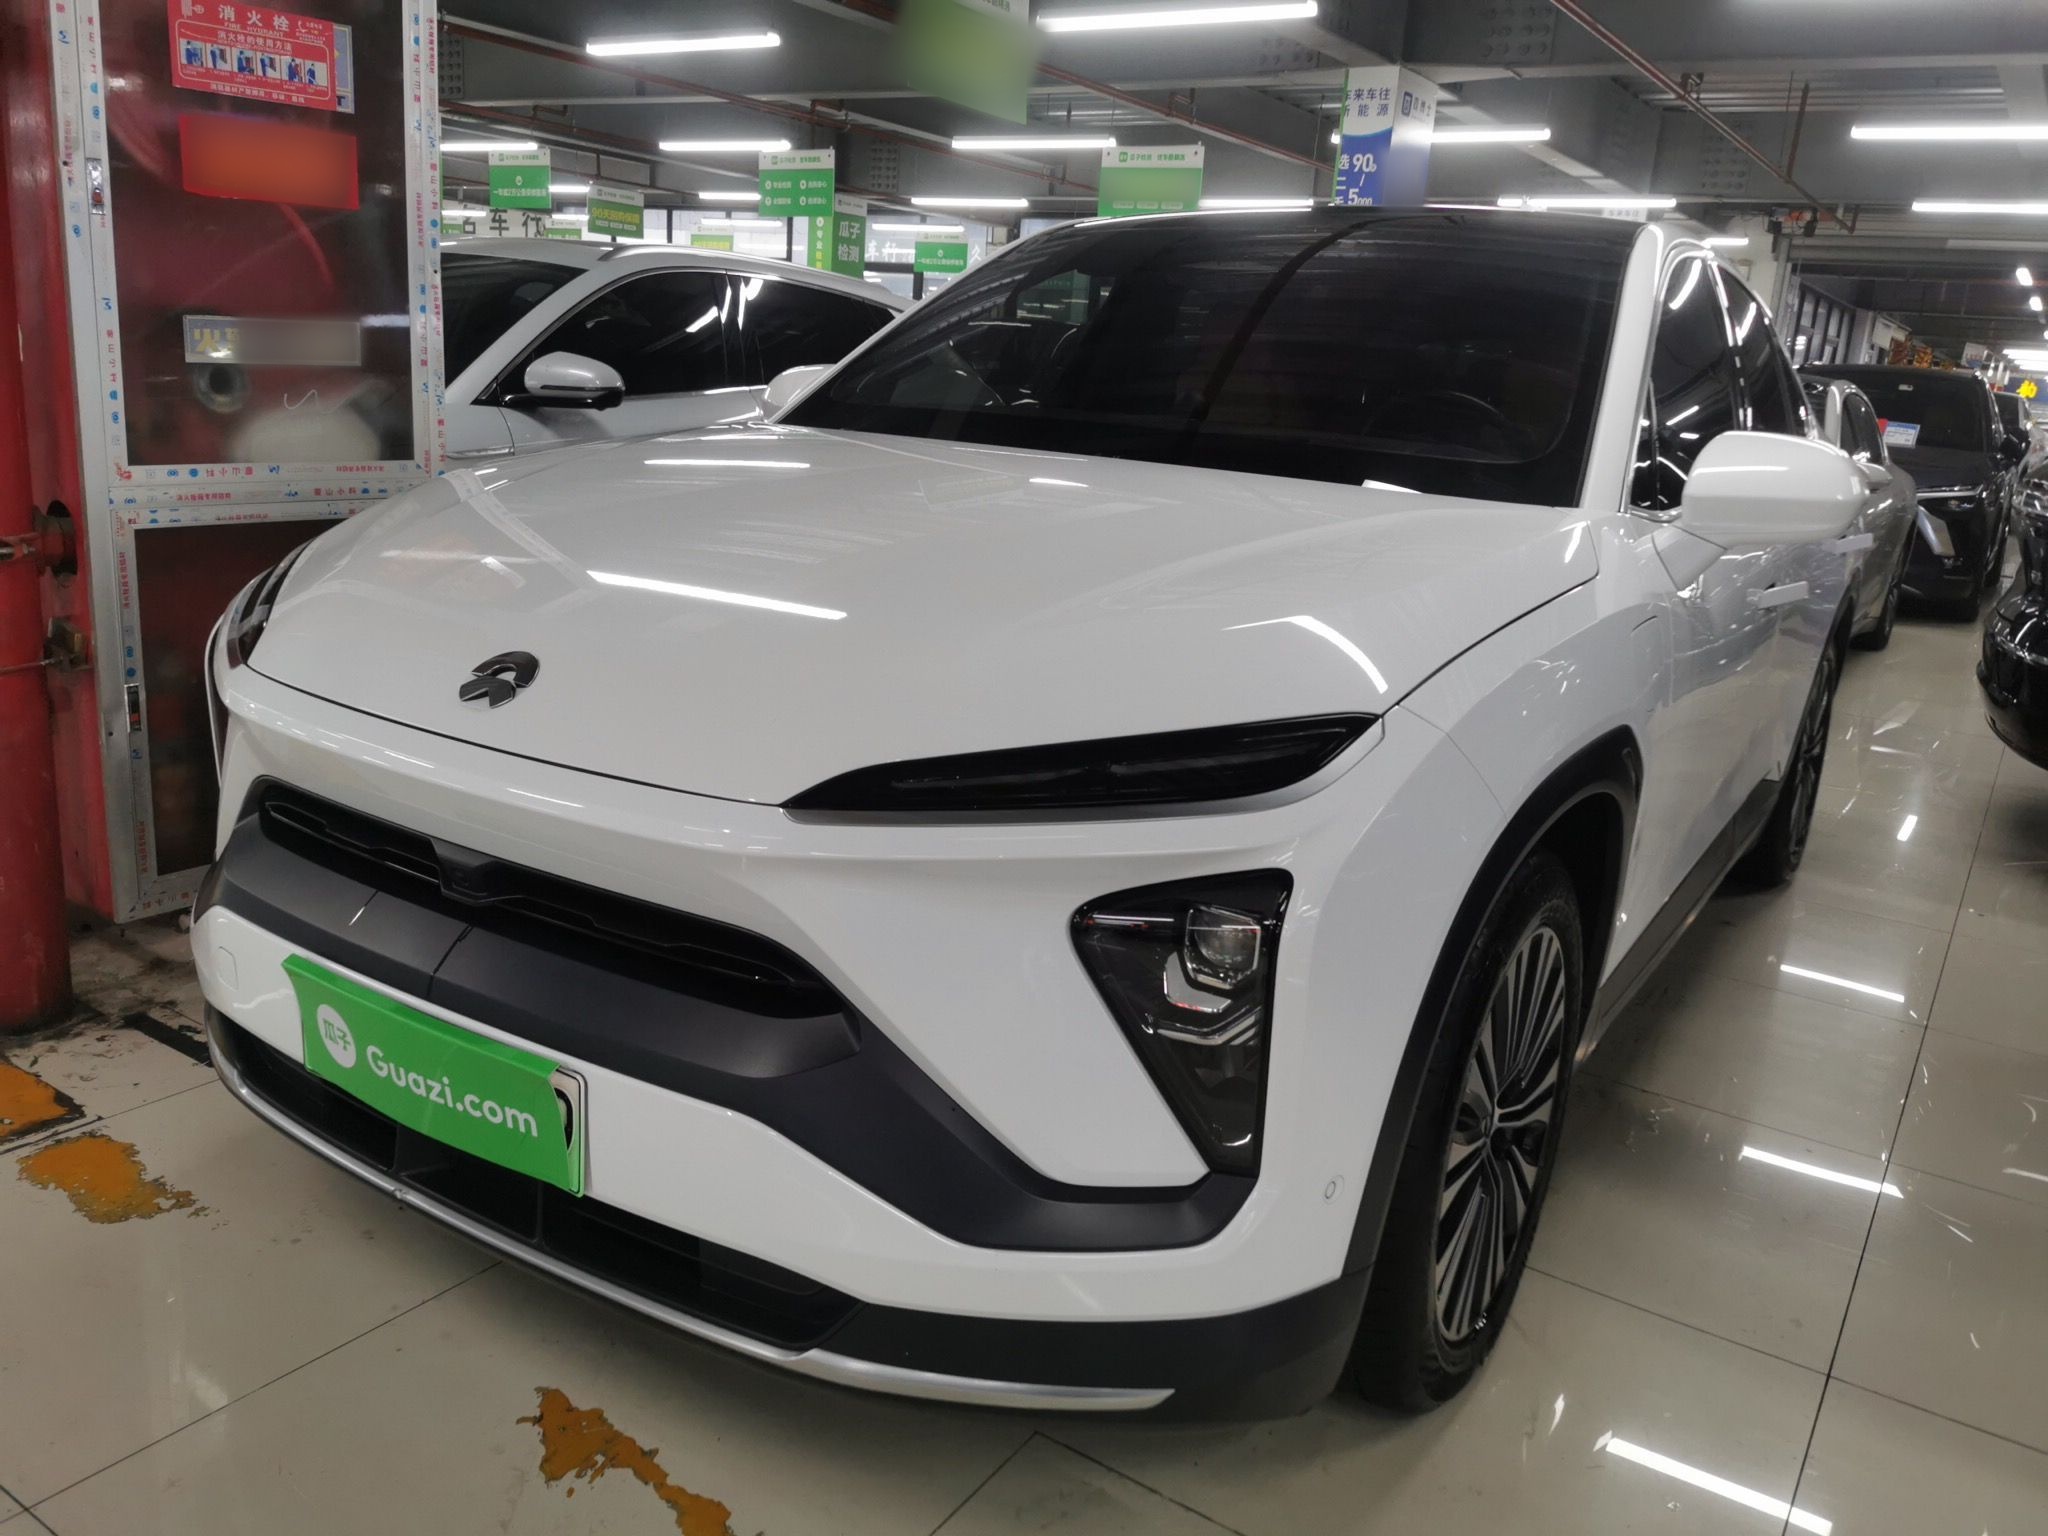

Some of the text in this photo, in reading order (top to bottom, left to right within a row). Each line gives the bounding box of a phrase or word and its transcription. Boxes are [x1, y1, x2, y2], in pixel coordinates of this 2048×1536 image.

[218, 4, 290, 32] 消火栓
[217, 31, 293, 52] 消火栓的使用方法
[838, 221, 861, 240] 瓜子
[838, 243, 860, 263] 检测
[322, 1018, 352, 1052] 瓜子
[366, 1045, 538, 1137] Guazi.com
